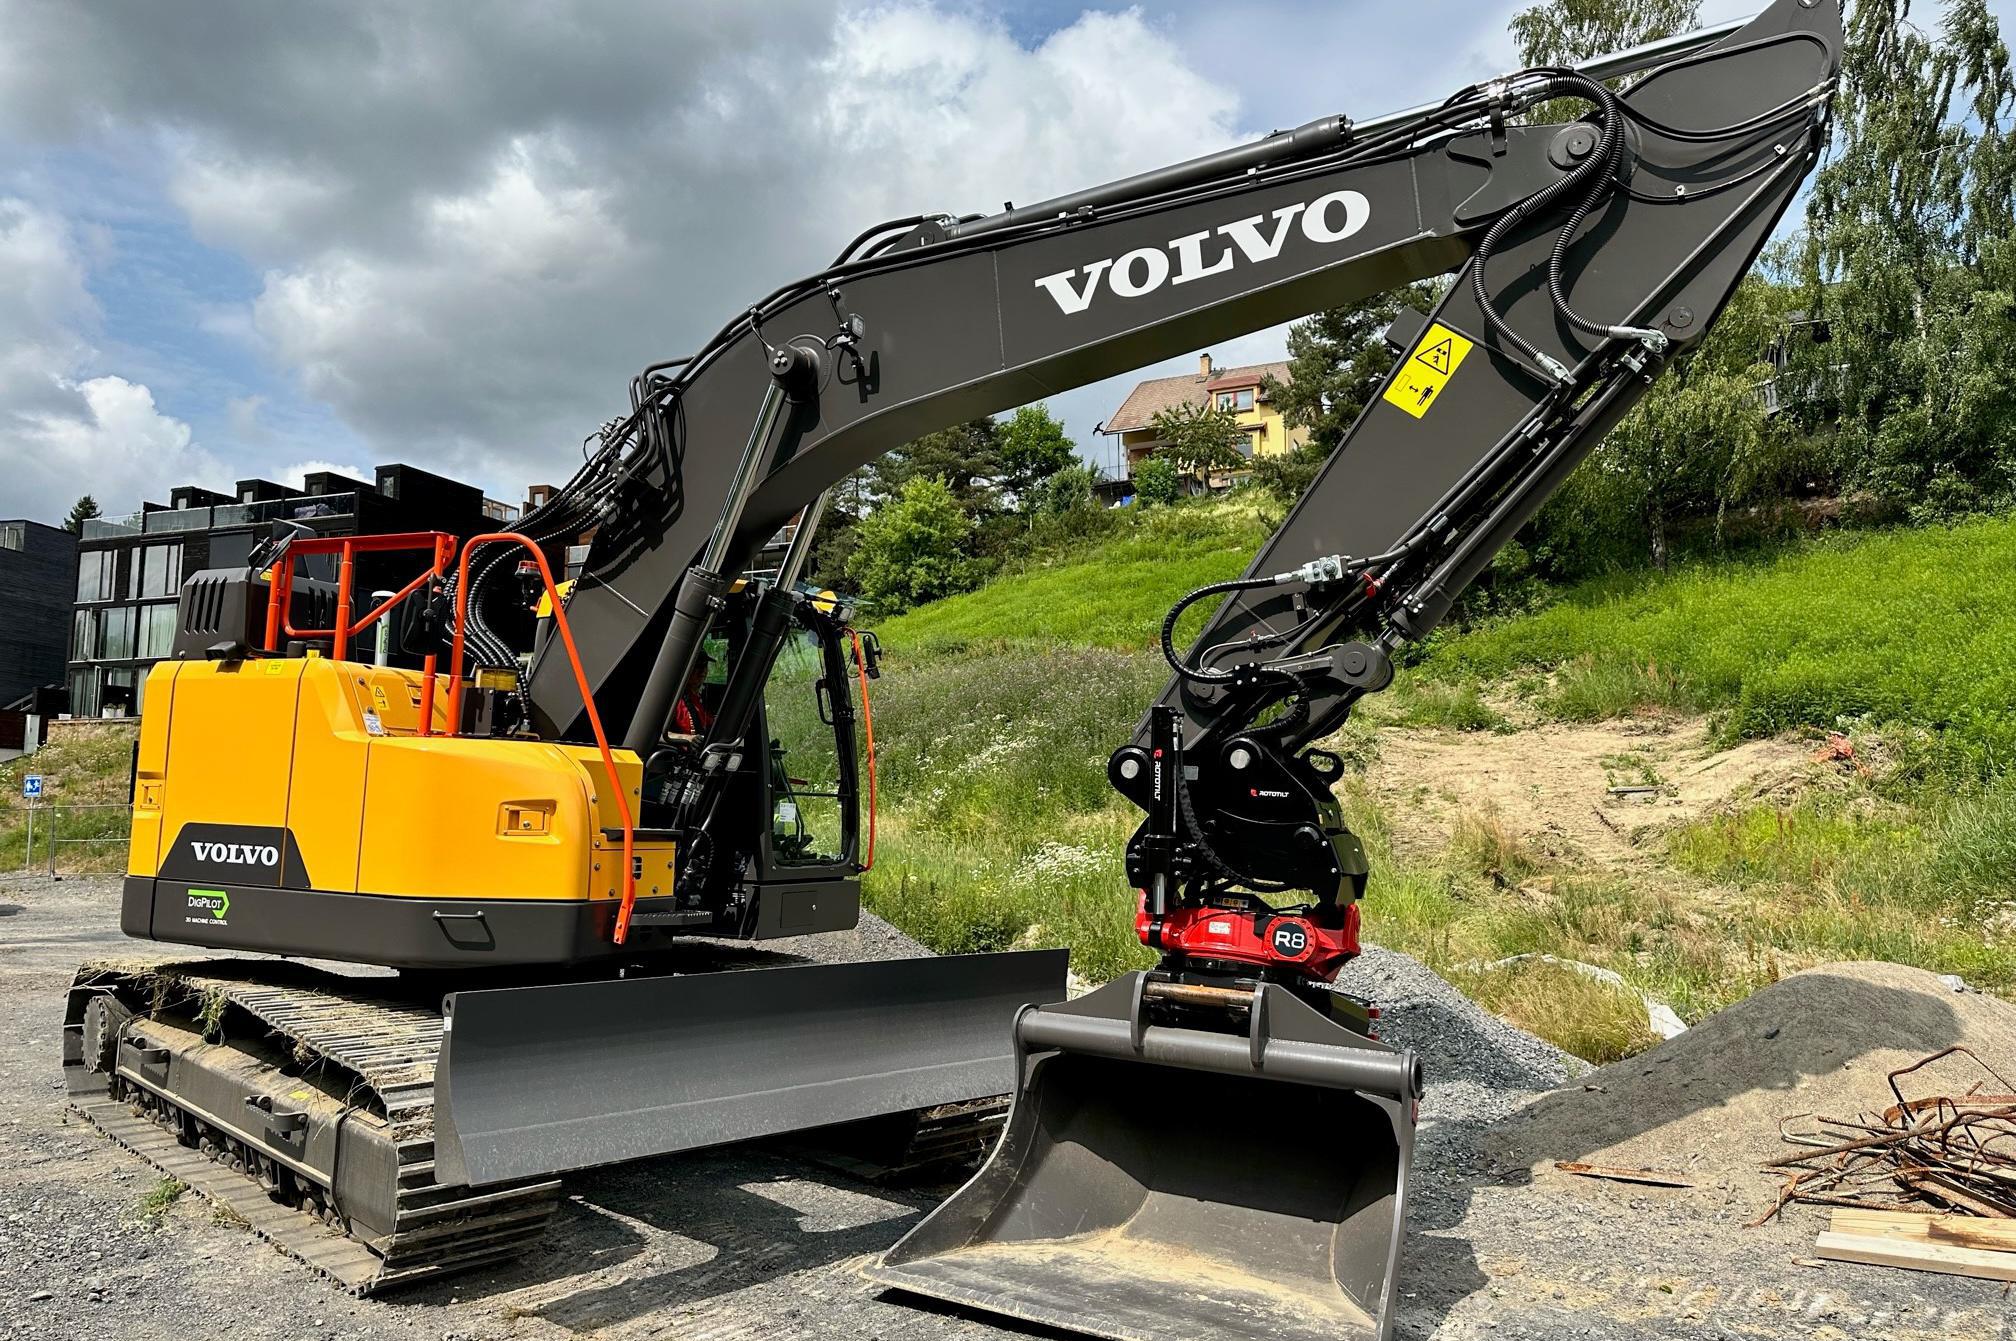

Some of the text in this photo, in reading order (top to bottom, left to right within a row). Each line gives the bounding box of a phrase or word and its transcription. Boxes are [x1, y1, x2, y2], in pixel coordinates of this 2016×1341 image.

[1035, 190, 1371, 315] VOLVO
[190, 841, 279, 866] VOLVO
[209, 918, 228, 926] CONTROL
[1275, 930, 1305, 949] R8
